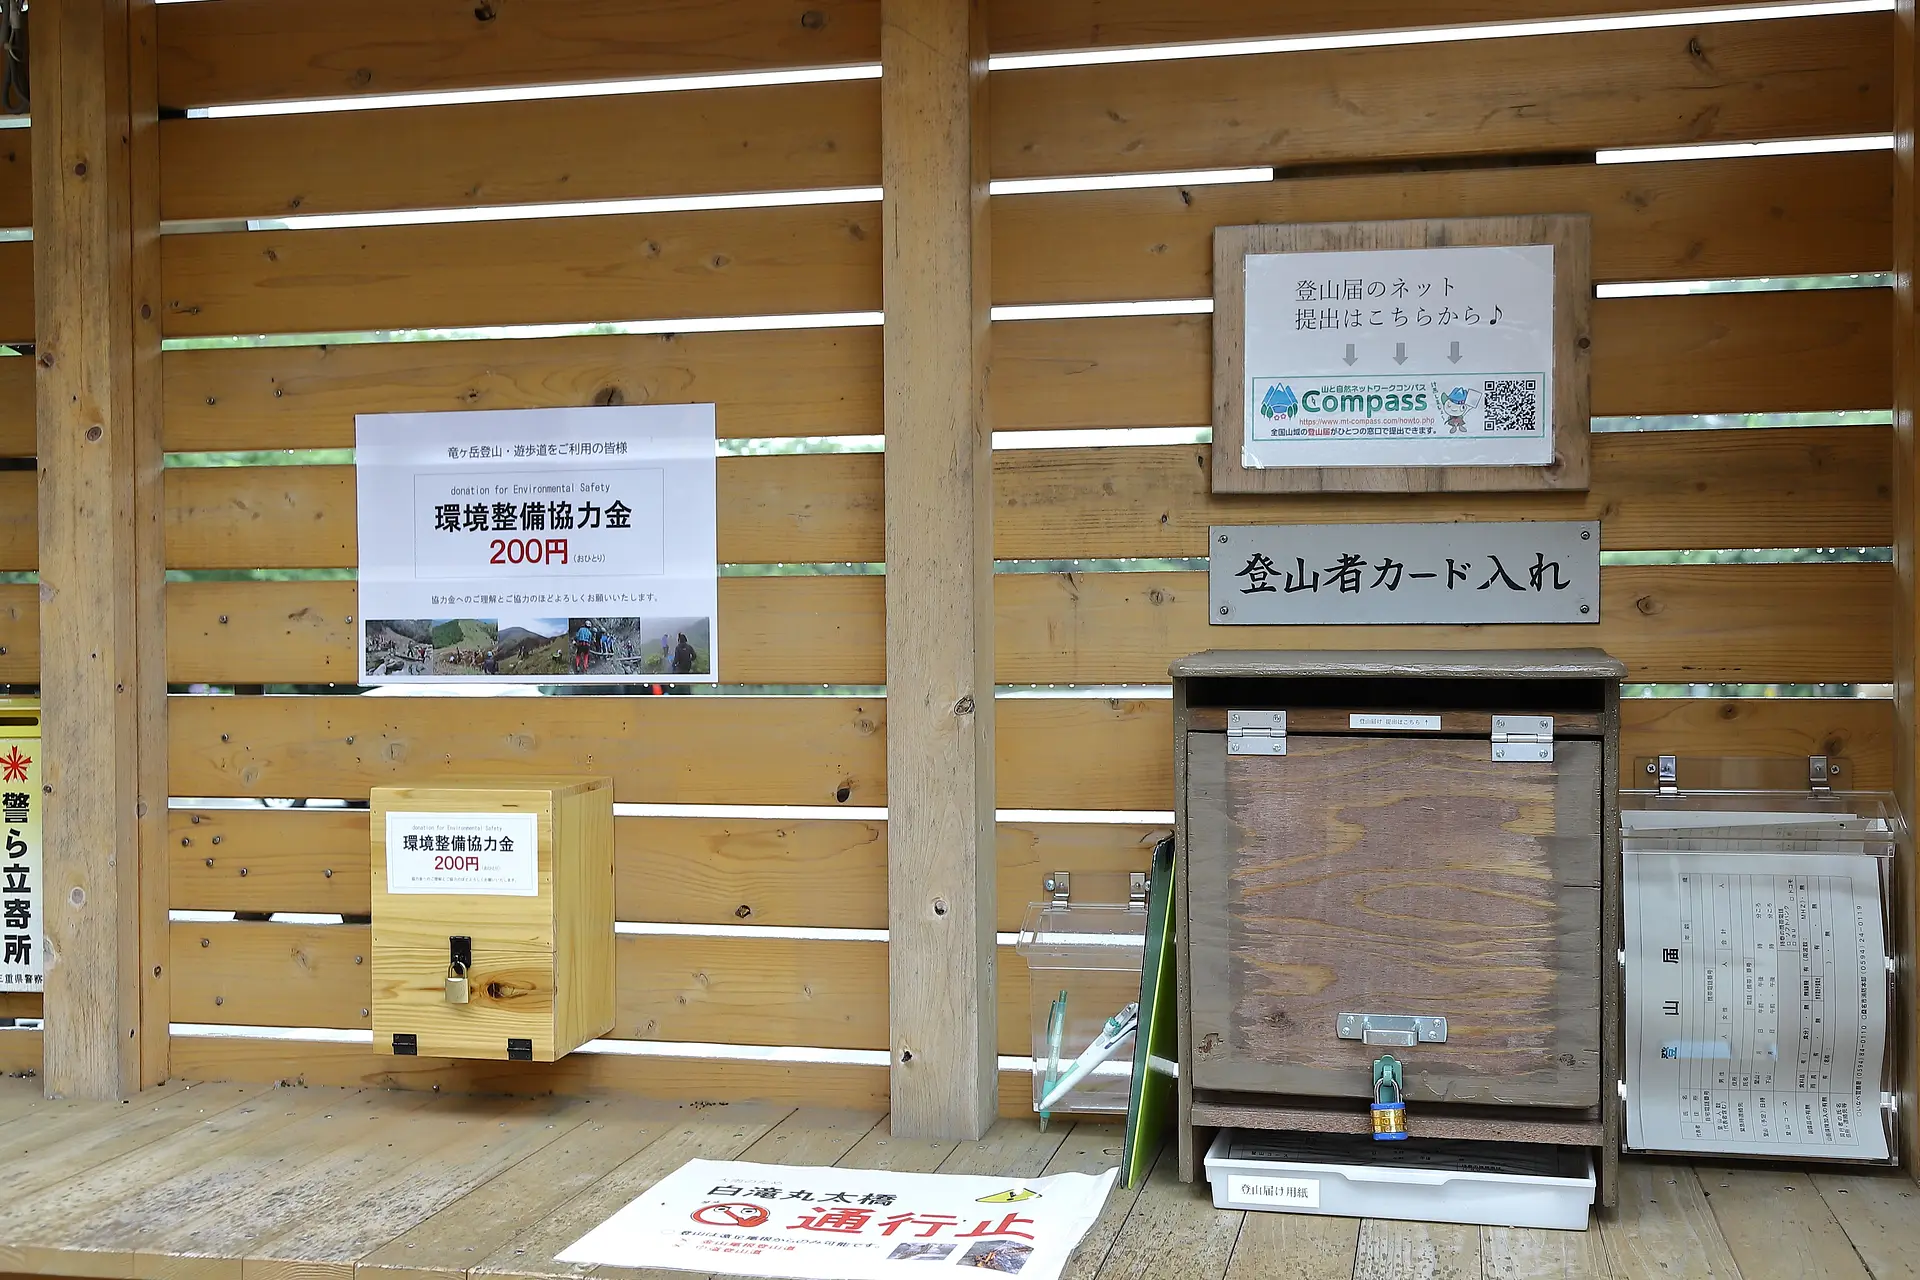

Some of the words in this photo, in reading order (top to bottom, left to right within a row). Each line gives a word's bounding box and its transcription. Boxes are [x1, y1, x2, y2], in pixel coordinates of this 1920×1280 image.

[1295, 277, 1456, 302] 登山届のネット
[1321, 383, 1426, 393] 山と自然ネットワークコンパス
[1301, 389, 1428, 418] Compass
[1299, 415, 1435, 427] https://www.mt-compass.com/howto.php
[1271, 426, 1438, 438] 全国山域の登山届がひとつの窓口で提出できます。
[450, 484, 490, 496] donation
[495, 484, 509, 494] for
[513, 483, 575, 494] Environmental
[580, 482, 611, 494] Safety
[434, 499, 633, 533] 環境整備協力金
[490, 538, 568, 566] 200円
[1234, 552, 1571, 595] 登山者カード入れ
[431, 592, 660, 606] 協力金へのご理解とご協力のほどよろしくお願いいたします。
[403, 835, 514, 852] 環境整備協力金
[434, 855, 479, 872] 200円
[2, 792, 31, 966] 警ら立寄所
[707, 1184, 898, 1206] 白滝丸太橋
[1240, 1183, 1310, 1199] 登山届け用紙
[786, 1206, 1035, 1240] 通行止
